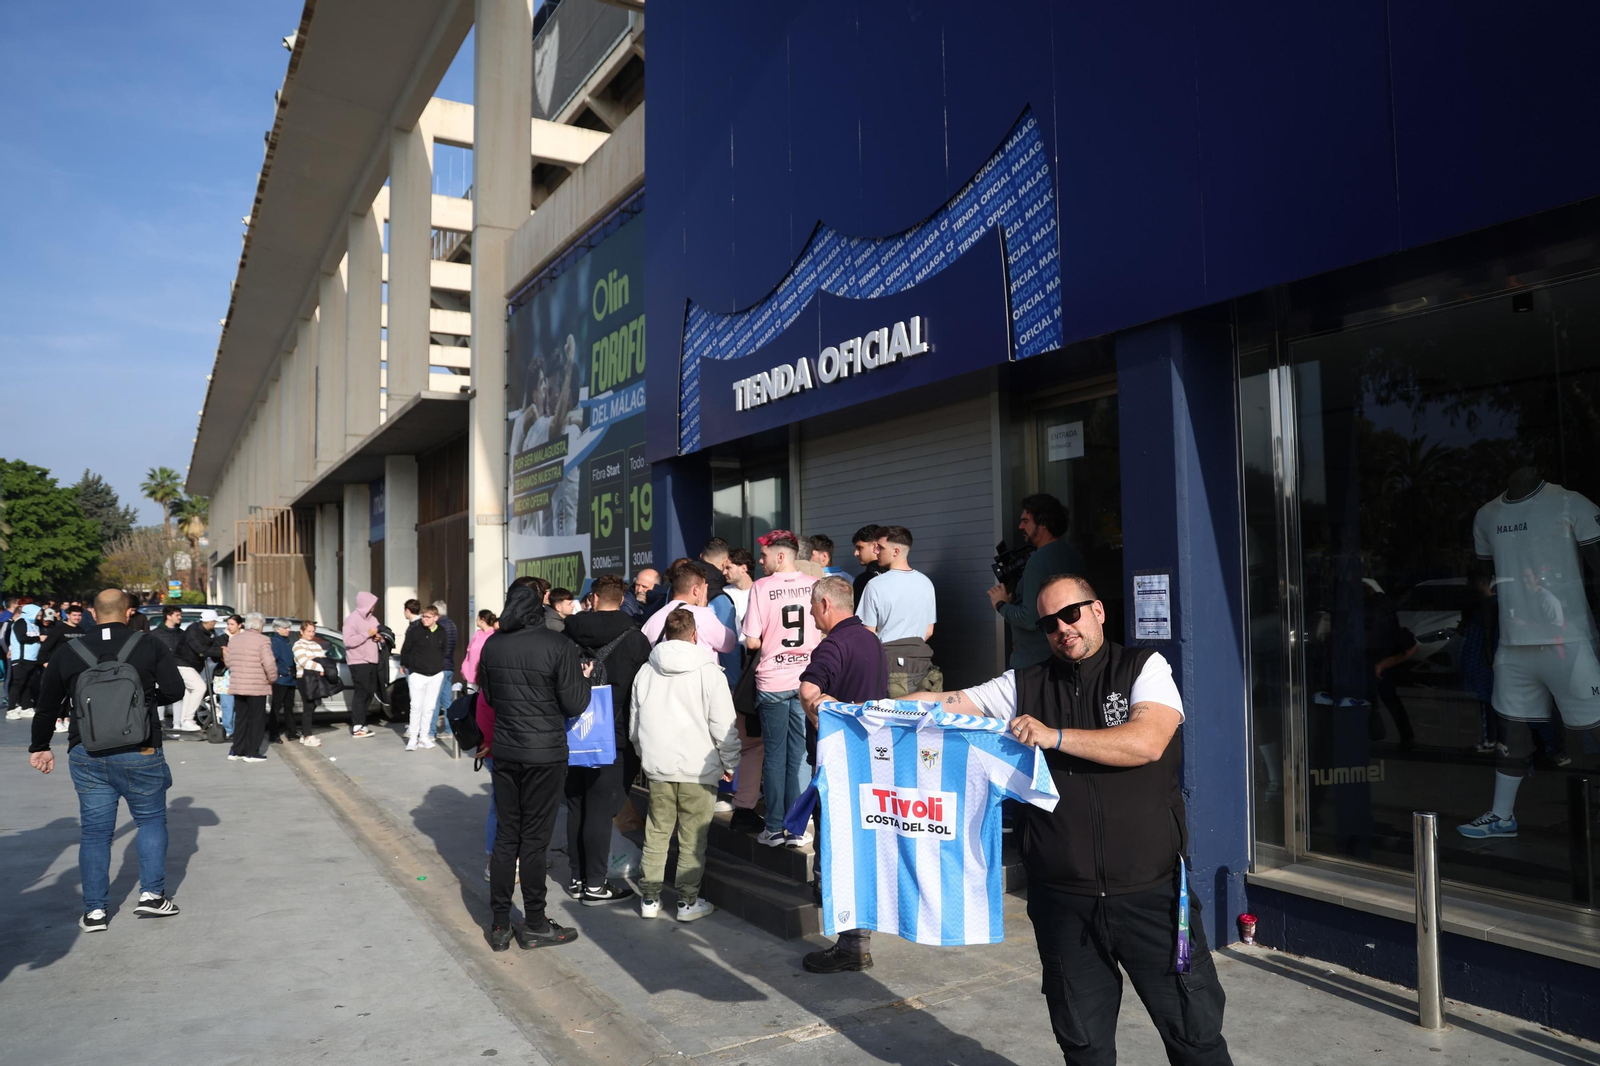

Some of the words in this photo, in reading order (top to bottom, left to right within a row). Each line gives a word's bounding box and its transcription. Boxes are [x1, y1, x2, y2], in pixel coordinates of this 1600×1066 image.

[1008, 130, 1040, 164] MALAG
[974, 150, 1004, 183] OFICIAL
[952, 203, 980, 232] TIENDA
[980, 172, 1011, 205] OFICIAL
[957, 225, 986, 255] TIENDA
[986, 195, 1018, 227] OFICIAL
[1005, 218, 1024, 240] CIAL
[854, 244, 876, 269] TIENDA
[858, 263, 880, 288] TIENDA
[880, 238, 905, 265] OFICIAL
[885, 260, 910, 286] OFICIAL
[910, 229, 940, 262] MALAGA
[940, 218, 949, 232] CF
[915, 252, 945, 284] MALAGA
[945, 240, 955, 253] CF
[797, 271, 817, 294] OFICIAL
[817, 245, 840, 273] MALAGA
[593, 268, 630, 321] Olin
[1013, 290, 1045, 321] OFICIAL
[1020, 314, 1053, 345] OFICIAL
[590, 314, 646, 396] FOROFO
[732, 356, 813, 412] TIENDA
[817, 315, 928, 384] OFICIAL
[592, 403, 609, 426] DEL
[1051, 430, 1077, 441] ENTRADA
[538, 465, 562, 483] NUESTRA
[592, 469, 606, 481] Fibra
[606, 463, 620, 477] Start
[629, 455, 645, 470] Todo
[530, 492, 549, 508] OFERTA
[591, 492, 613, 539] 15
[630, 482, 653, 533] 19
[1497, 522, 1528, 534] MALAGA
[782, 604, 805, 648] 9
[872, 788, 943, 822] Tivoli
[866, 814, 899, 829] COSTA
[902, 822, 925, 832] DEL
[928, 823, 951, 836] SOL
